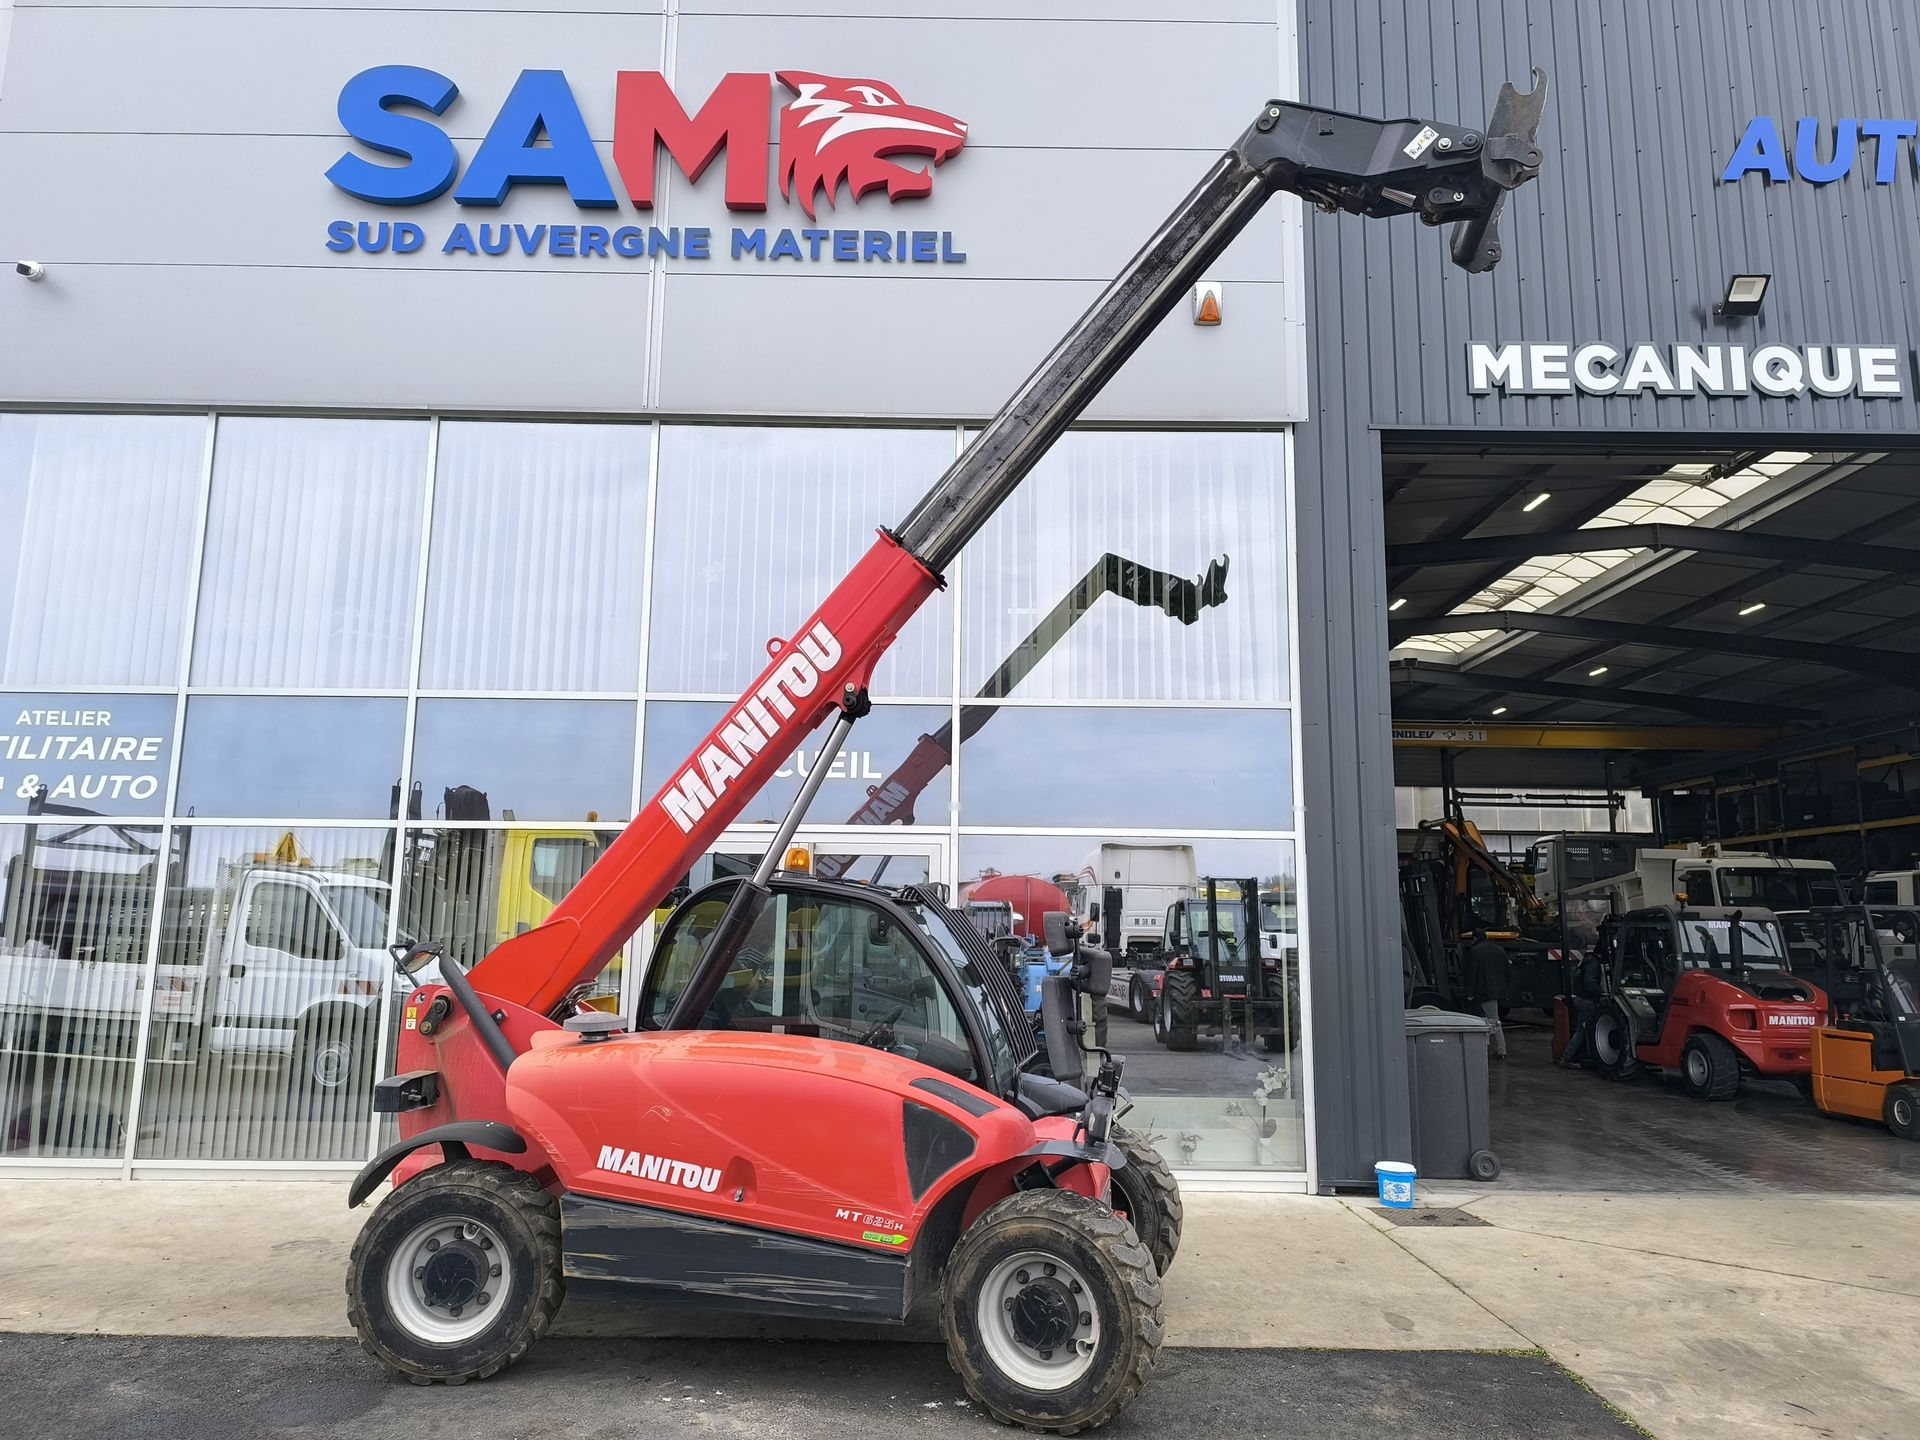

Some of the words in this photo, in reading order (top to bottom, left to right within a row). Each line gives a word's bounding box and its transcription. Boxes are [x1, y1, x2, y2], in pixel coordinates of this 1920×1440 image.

[325, 64, 770, 211] SAM
[1721, 115, 1920, 184] AUT
[326, 220, 425, 254] SUD
[441, 222, 711, 259] AUVERGNE
[730, 226, 967, 264] MATERIEL
[1469, 341, 1903, 398] MECANIQUE
[15, 710, 112, 727] ATELIER
[658, 618, 842, 835] MANITOU
[16, 773, 41, 799] &
[49, 774, 158, 800] AUTO
[1768, 1015, 1816, 1026] MANITOU
[596, 1144, 722, 1193] MANITOU
